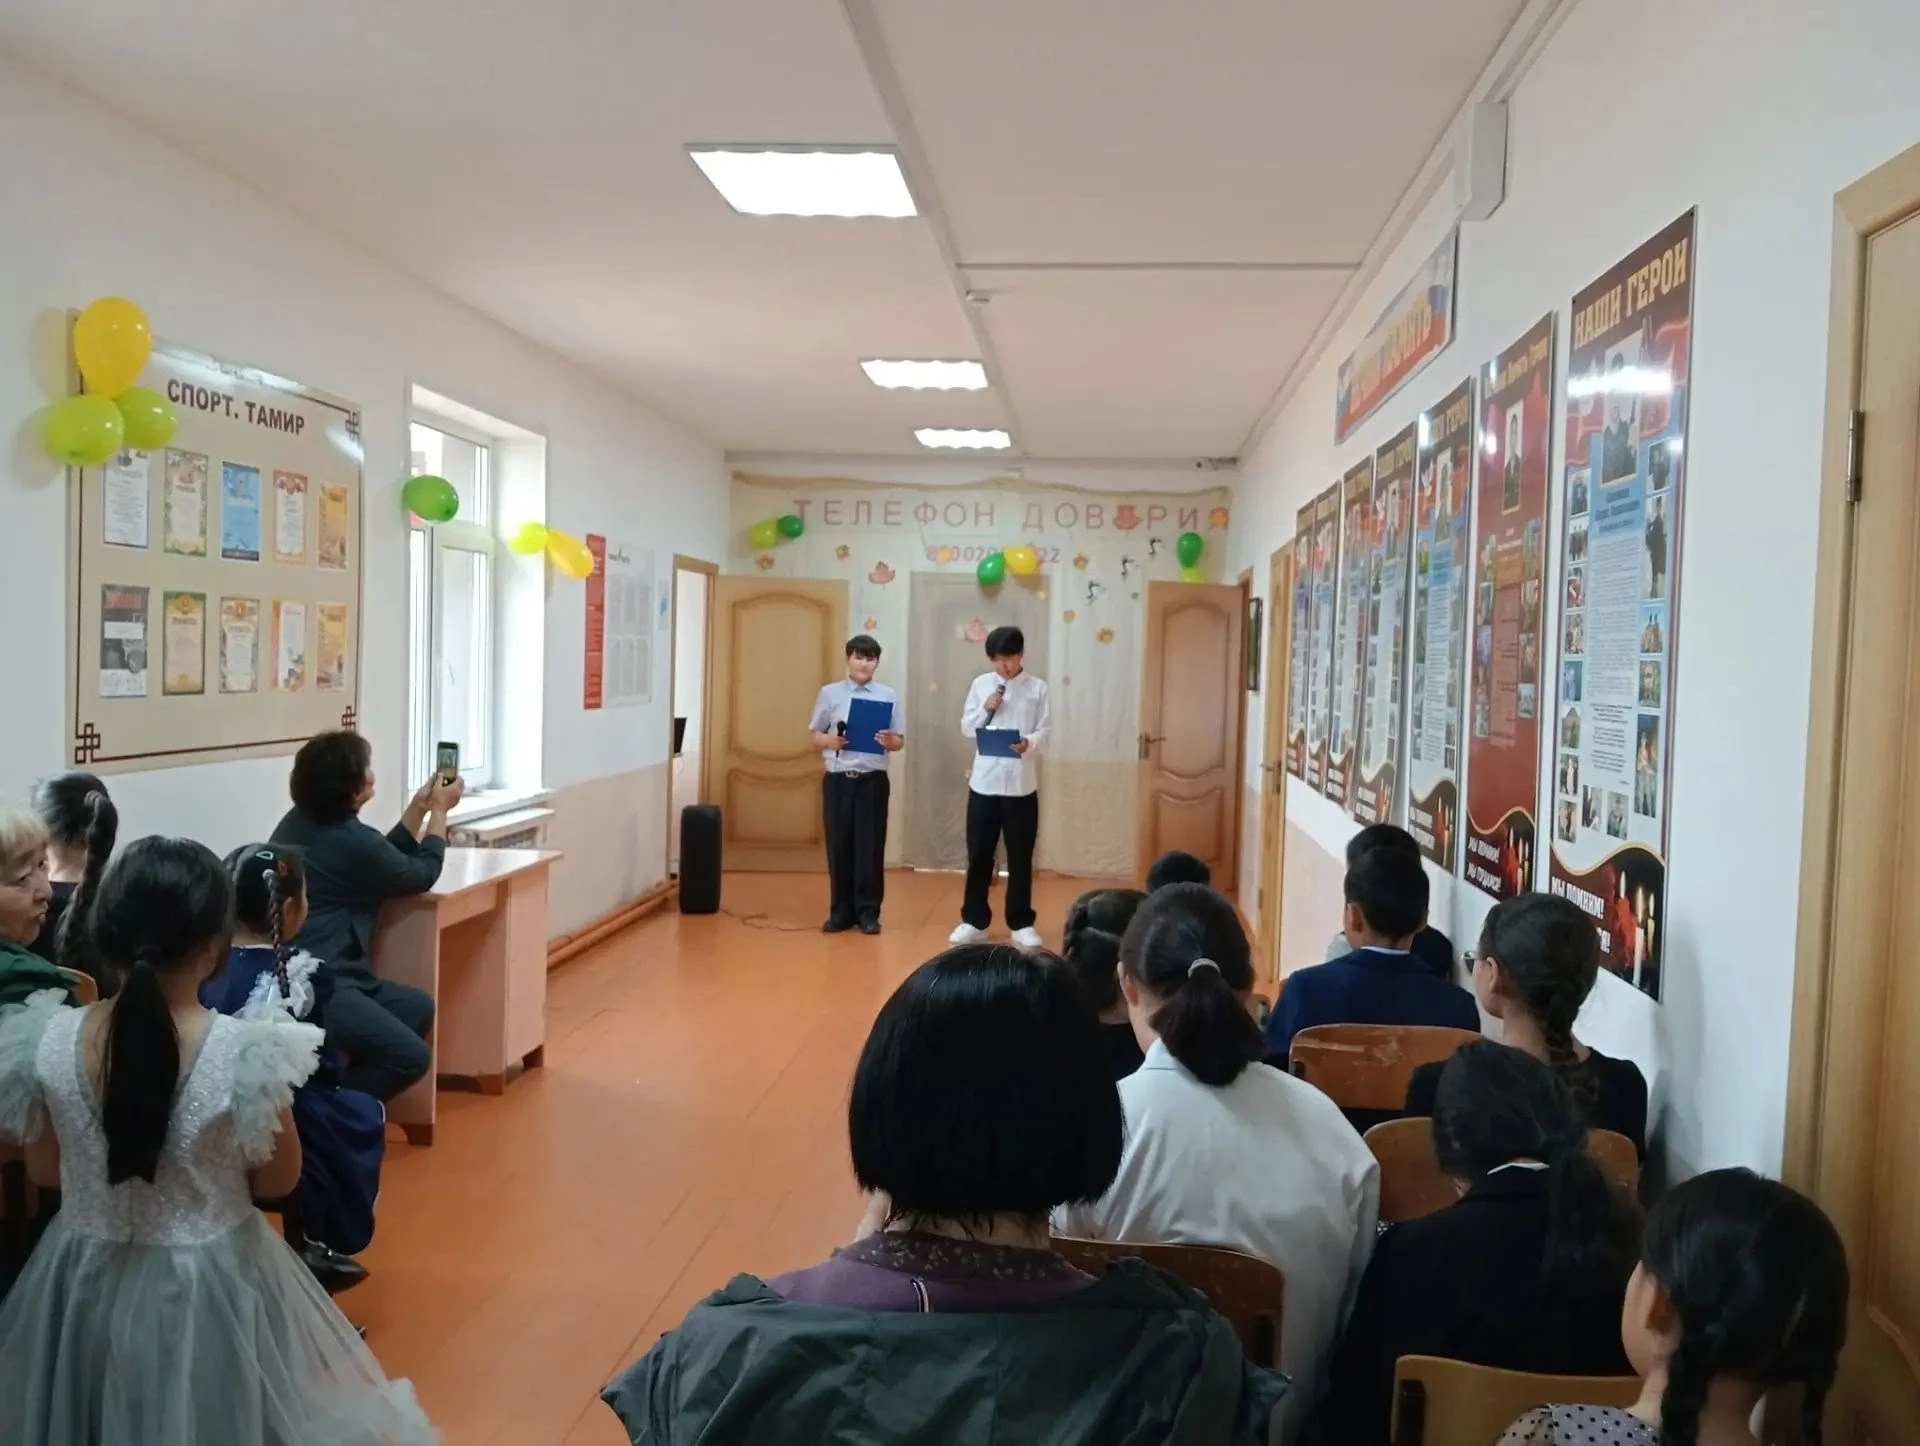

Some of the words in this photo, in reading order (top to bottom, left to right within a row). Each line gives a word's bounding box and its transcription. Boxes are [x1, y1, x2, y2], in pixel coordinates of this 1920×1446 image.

[1574, 284, 1622, 352] НАШИ
[1626, 237, 1688, 318] ГЕРОИ
[167, 378, 239, 419] СПОРТ.
[245, 401, 305, 435] ТАМИР
[793, 499, 995, 527] ТЕЛЕФОН
[1022, 502, 1229, 532] ДОВРИ
[1551, 876, 1566, 898] МЫ
[1566, 882, 1605, 920] ПОМНИМ!
